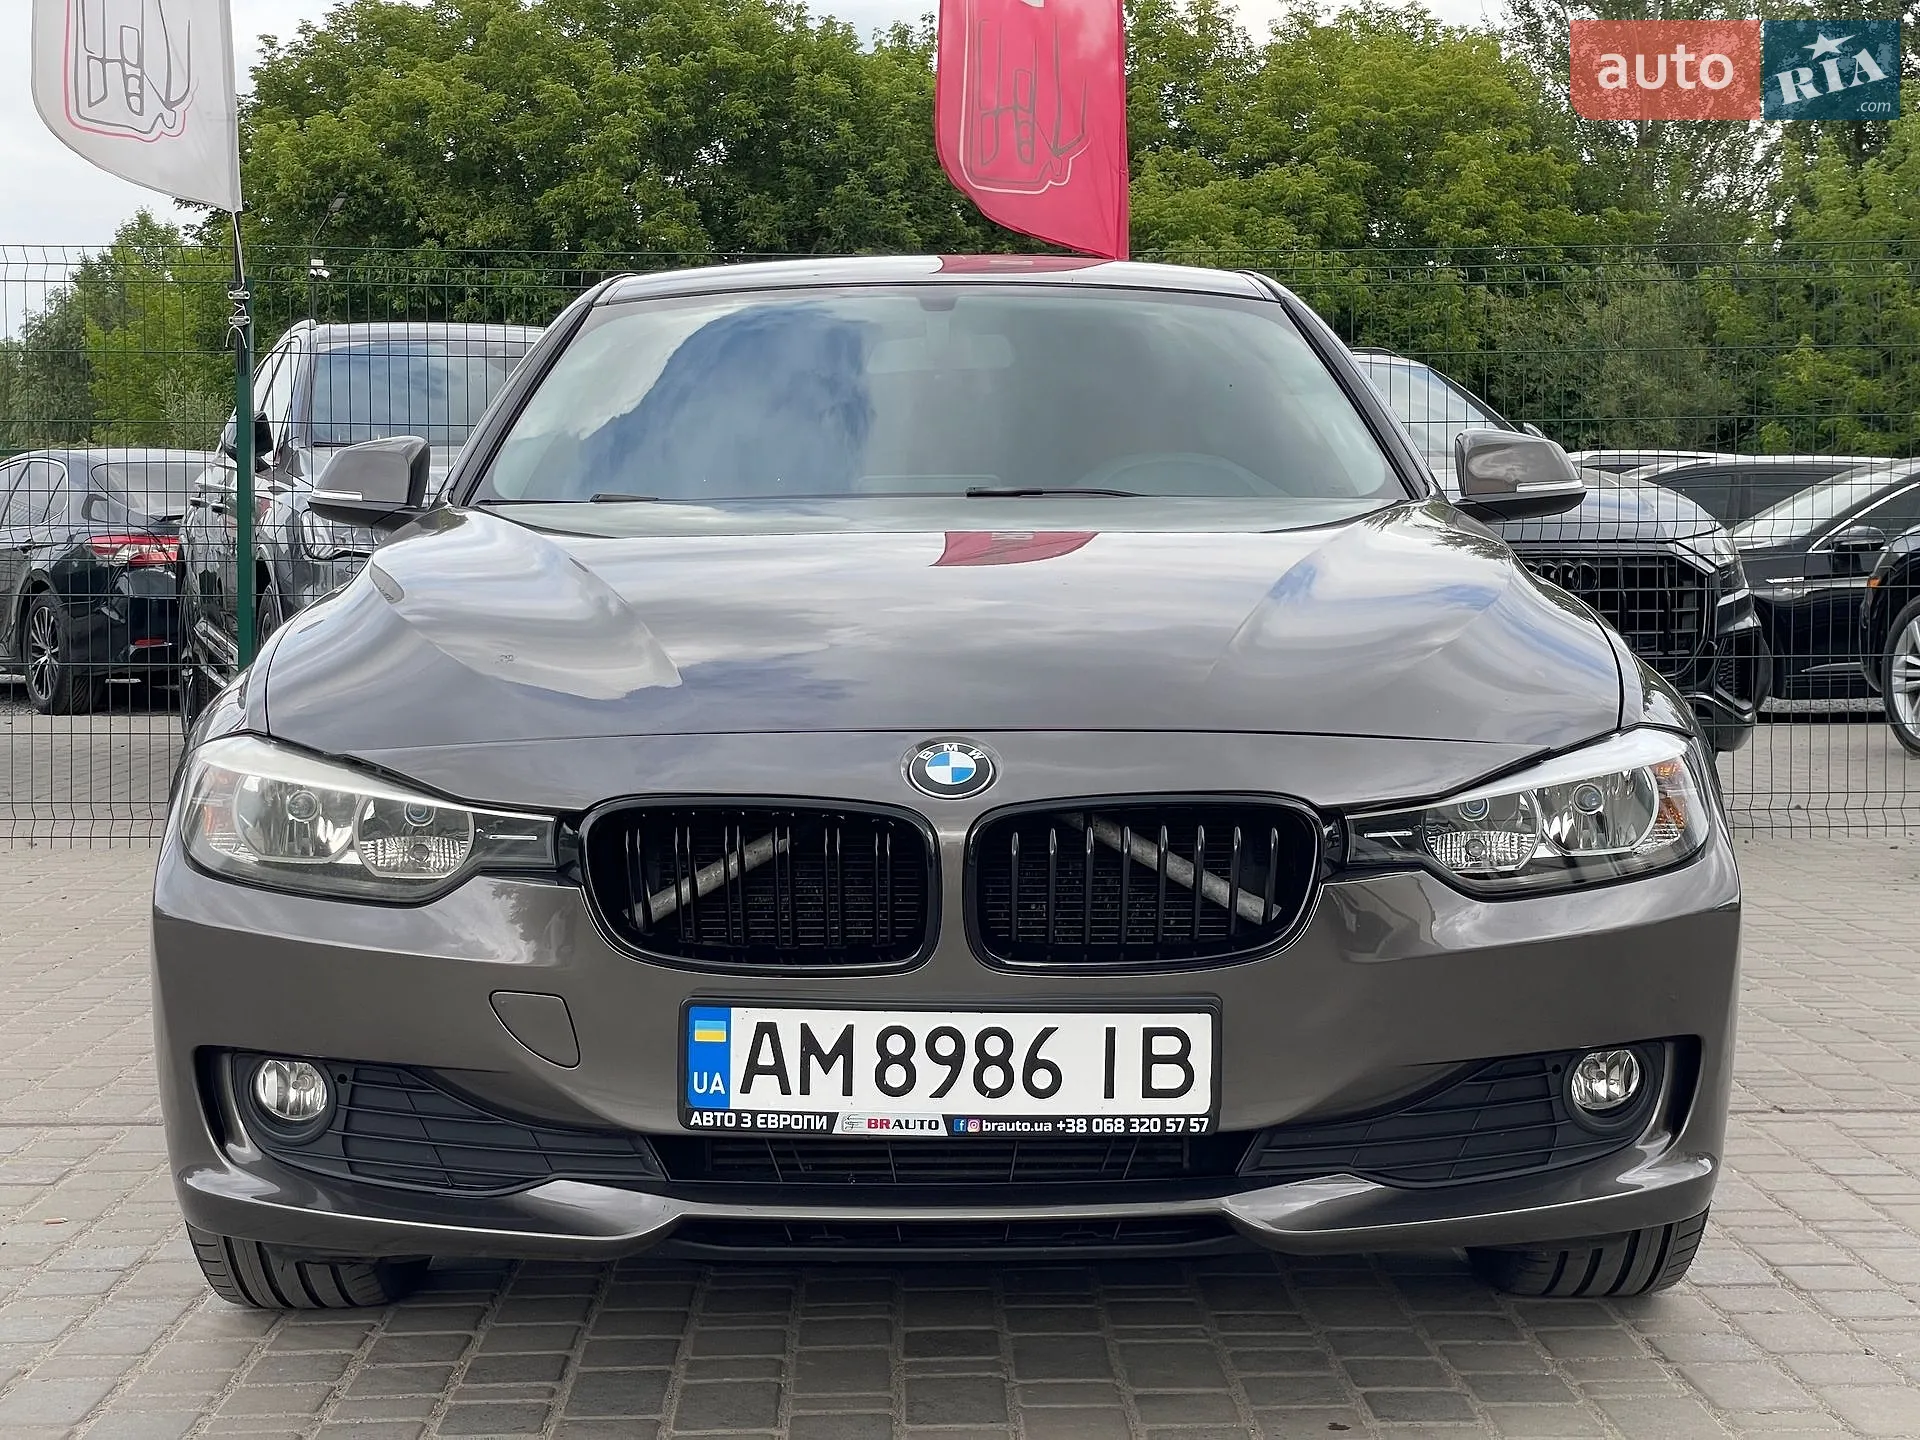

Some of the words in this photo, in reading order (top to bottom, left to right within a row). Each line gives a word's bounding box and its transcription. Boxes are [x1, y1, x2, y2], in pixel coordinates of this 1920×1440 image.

[918, 743, 985, 761] BMW
[739, 1022, 854, 1096] AM
[874, 1025, 1063, 1099] 8986
[1103, 1026, 1195, 1099] IB
[693, 1071, 726, 1094] UA
[690, 1111, 736, 1128] АВТО
[756, 1114, 828, 1130] ЄВРОПИ
[867, 1118, 940, 1131] BRAUTO
[982, 1119, 1052, 1132] brauto.ua
[1057, 1118, 1087, 1133] +38
[1092, 1117, 1124, 1133] 068
[1129, 1117, 1160, 1133] 320
[1165, 1117, 1185, 1133] 57
[1189, 1117, 1209, 1132] 57
